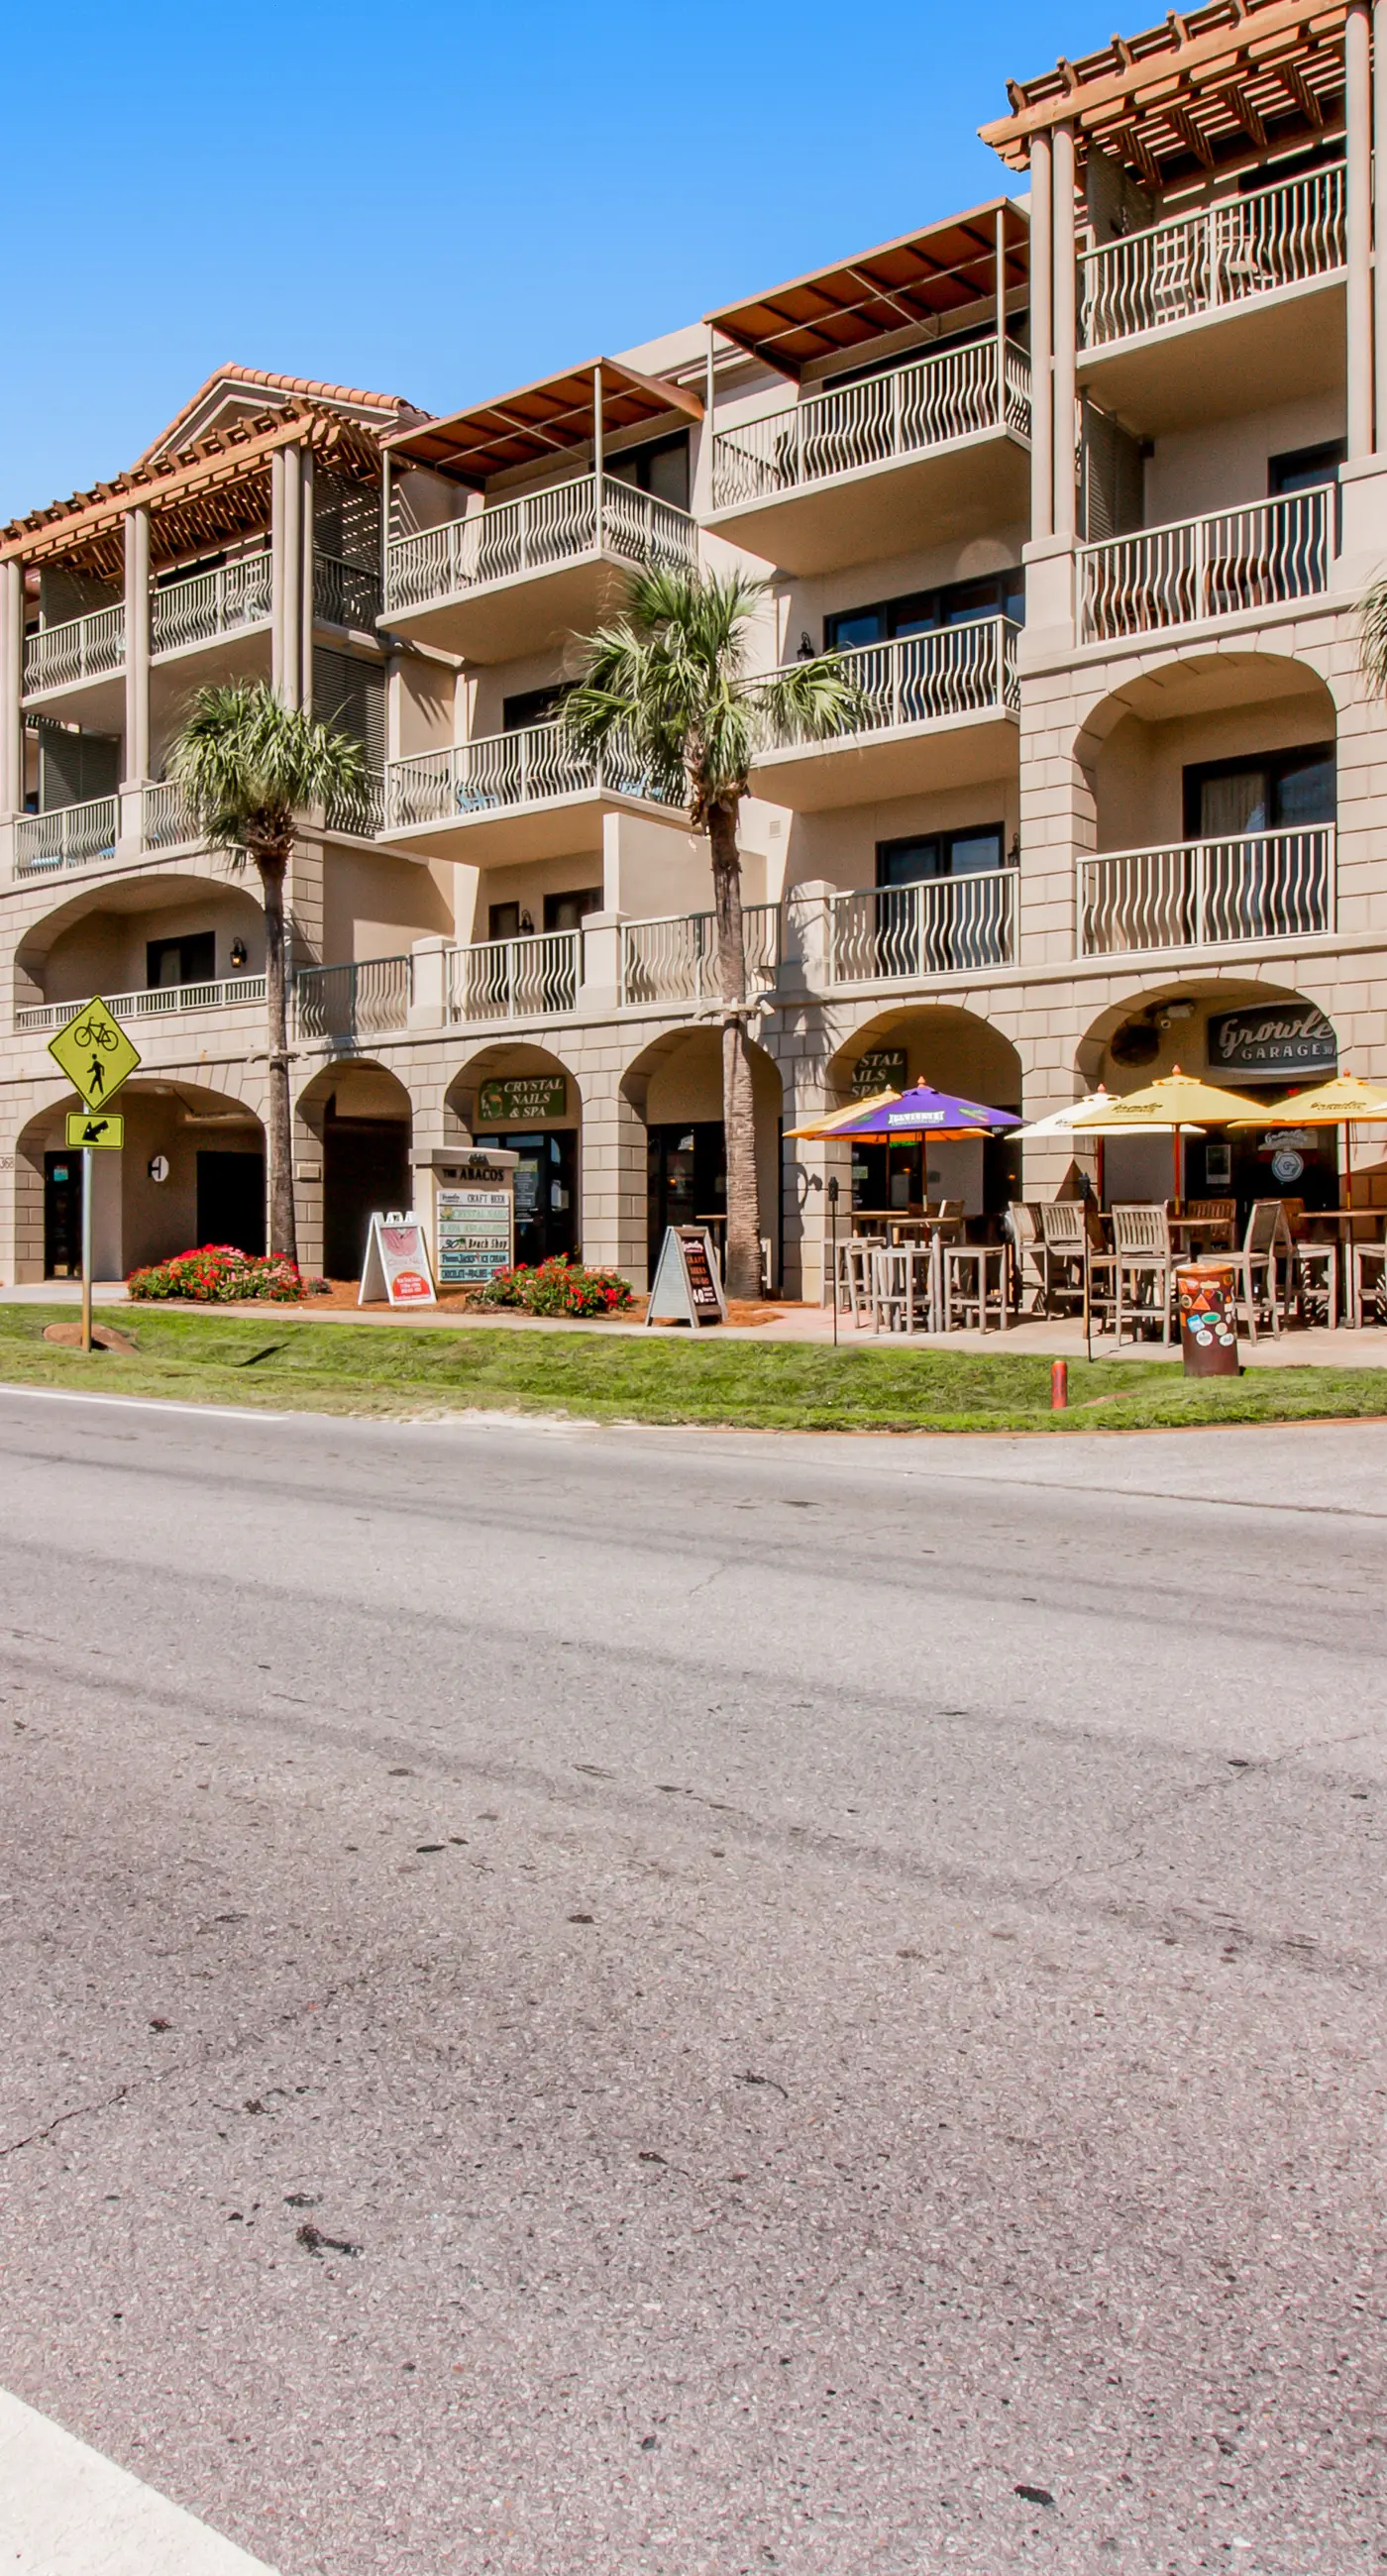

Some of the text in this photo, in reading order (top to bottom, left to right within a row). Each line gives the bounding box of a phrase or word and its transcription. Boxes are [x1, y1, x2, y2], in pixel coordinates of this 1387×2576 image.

[1241, 1042, 1321, 1060] GARAGE
[503, 1078, 564, 1093] CRYSTAL
[511, 1092, 551, 1106] NAILS
[509, 1106, 546, 1119] & SPA
[460, 1167, 504, 1182] ABACOS
[467, 1194, 488, 1204] CRAFT
[468, 1237, 488, 1248] Beach
[490, 1237, 507, 1250] Shop
